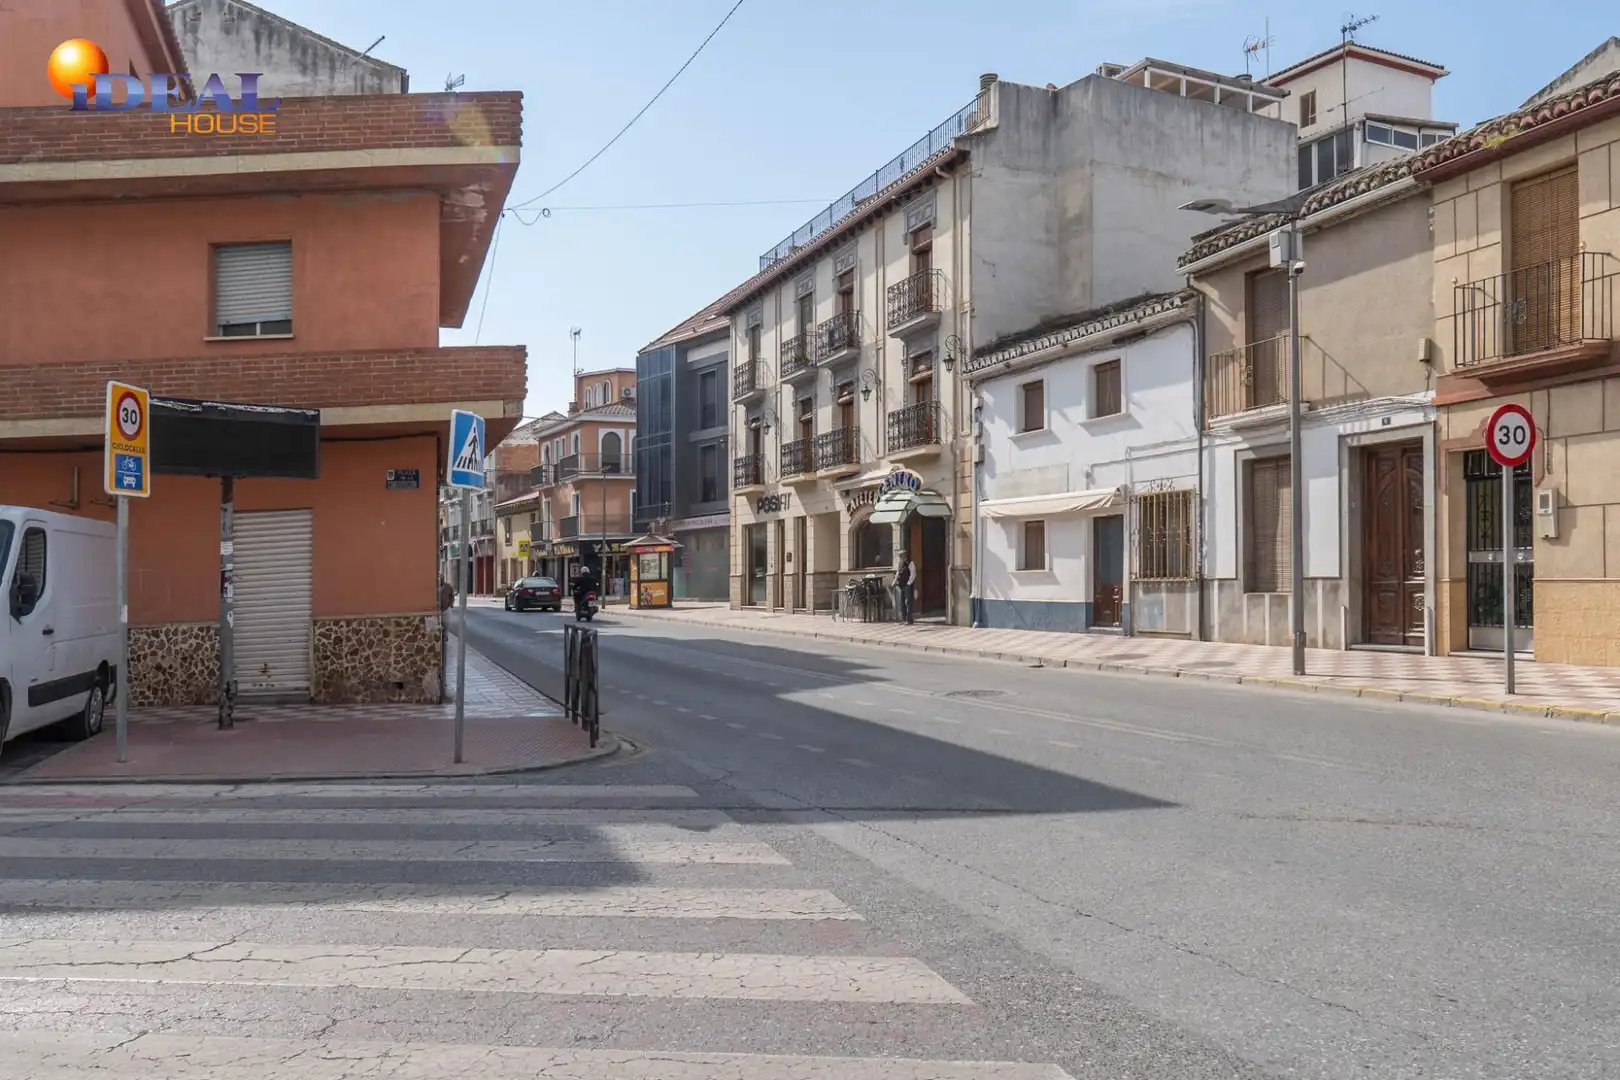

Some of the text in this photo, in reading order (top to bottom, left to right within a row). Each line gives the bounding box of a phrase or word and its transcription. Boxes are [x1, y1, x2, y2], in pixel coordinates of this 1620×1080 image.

[122, 407, 138, 425] 30
[1498, 424, 1526, 446] 30
[846, 490, 880, 514] CAFETER
